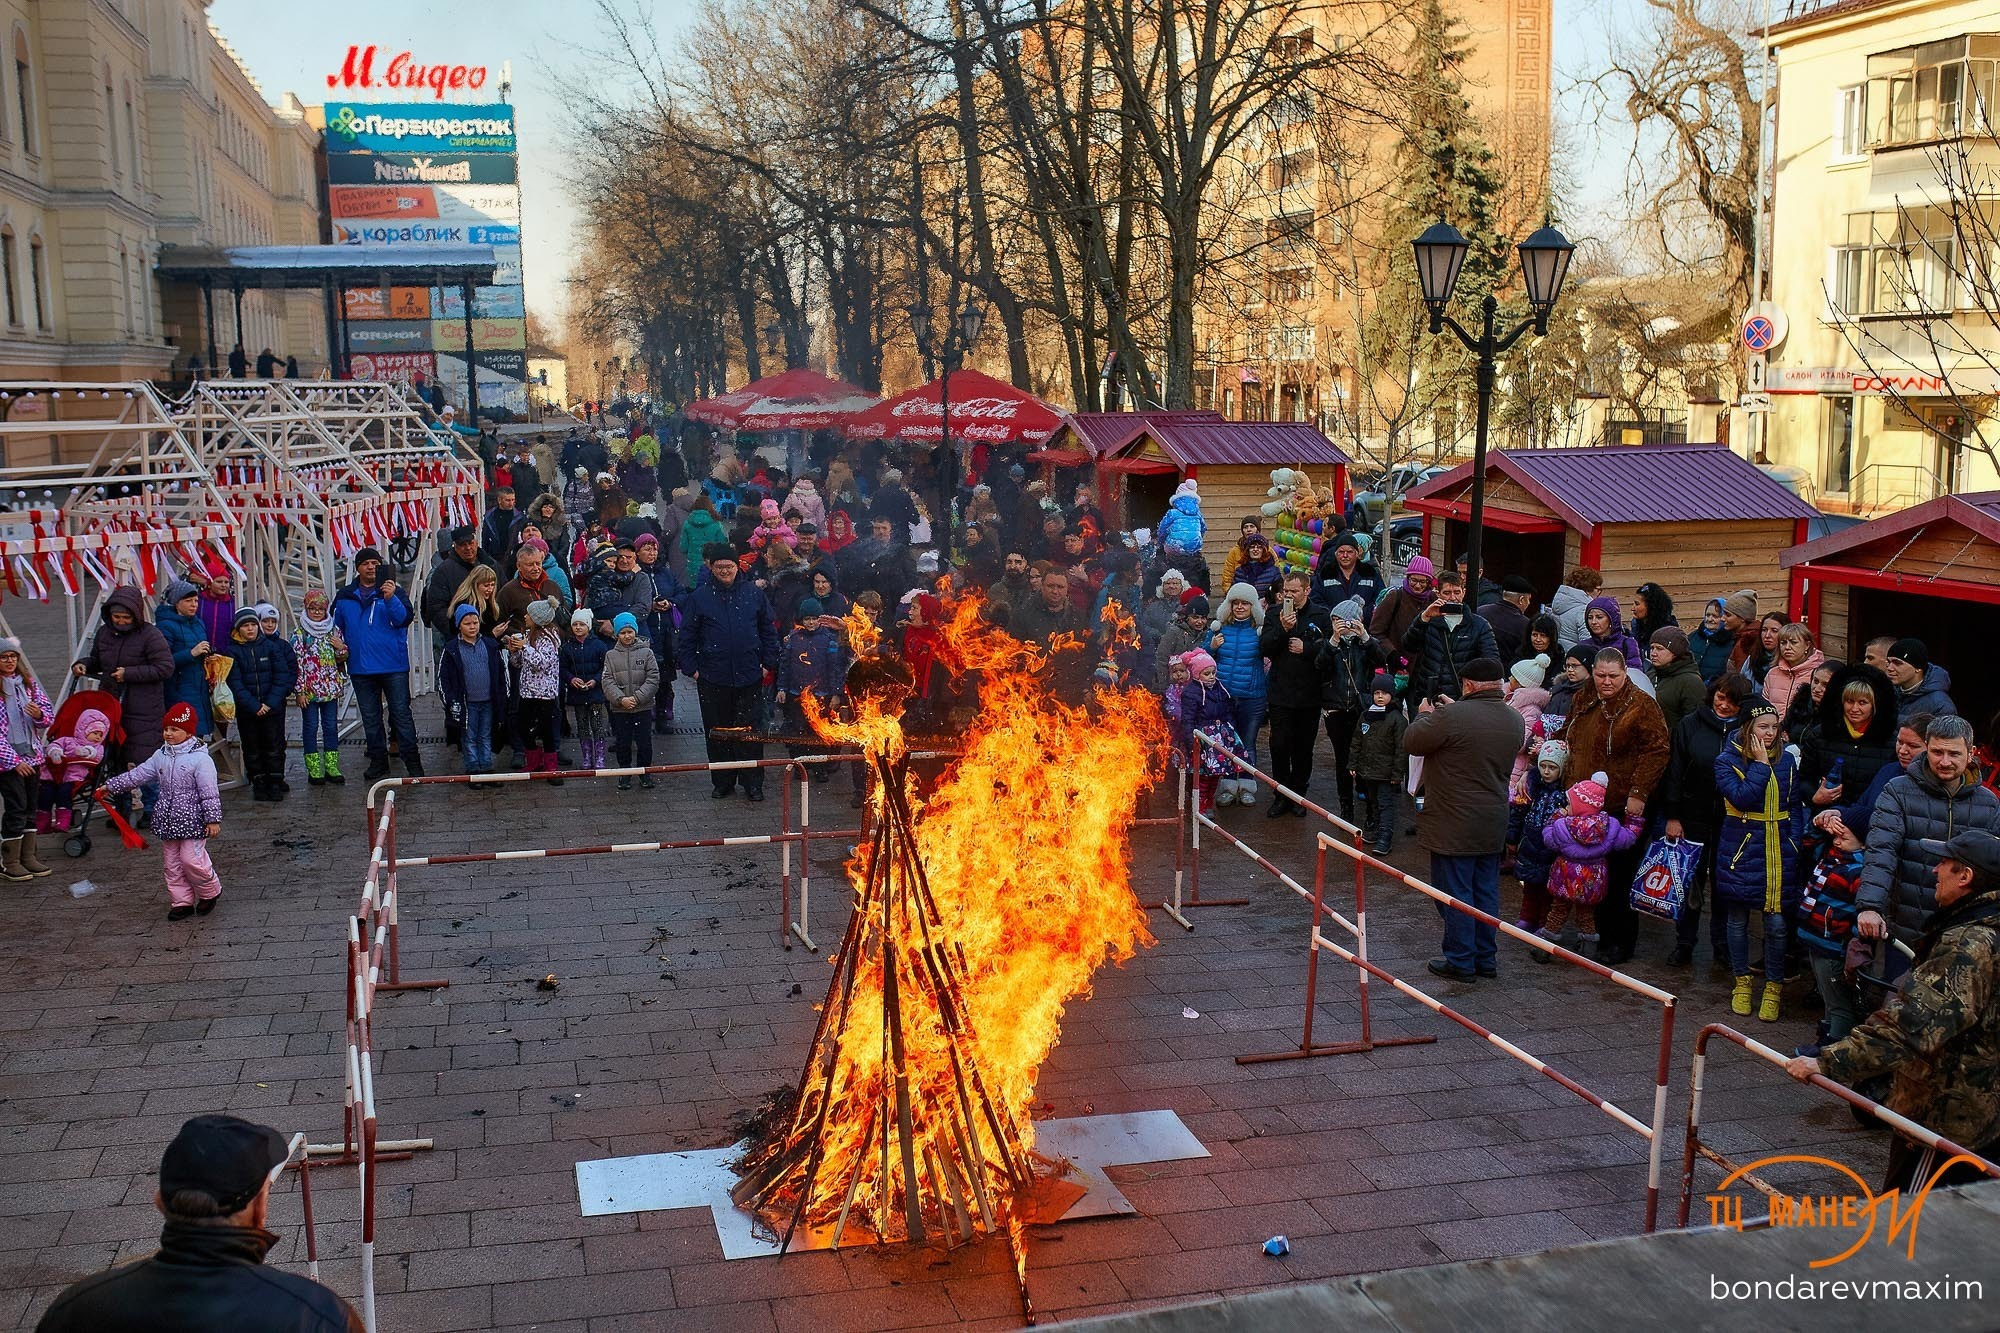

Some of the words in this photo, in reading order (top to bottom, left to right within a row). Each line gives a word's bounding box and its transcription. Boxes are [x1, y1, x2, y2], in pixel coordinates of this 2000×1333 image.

[480, 199, 516, 209] ЭТАЖ
[363, 224, 462, 244] кораблик
[476, 228, 487, 243] 2
[405, 292, 414, 305] 2
[376, 355, 430, 367] БУРГЕР
[1785, 371, 1812, 381] САЛОН
[1853, 377, 1941, 391] DOMANI
